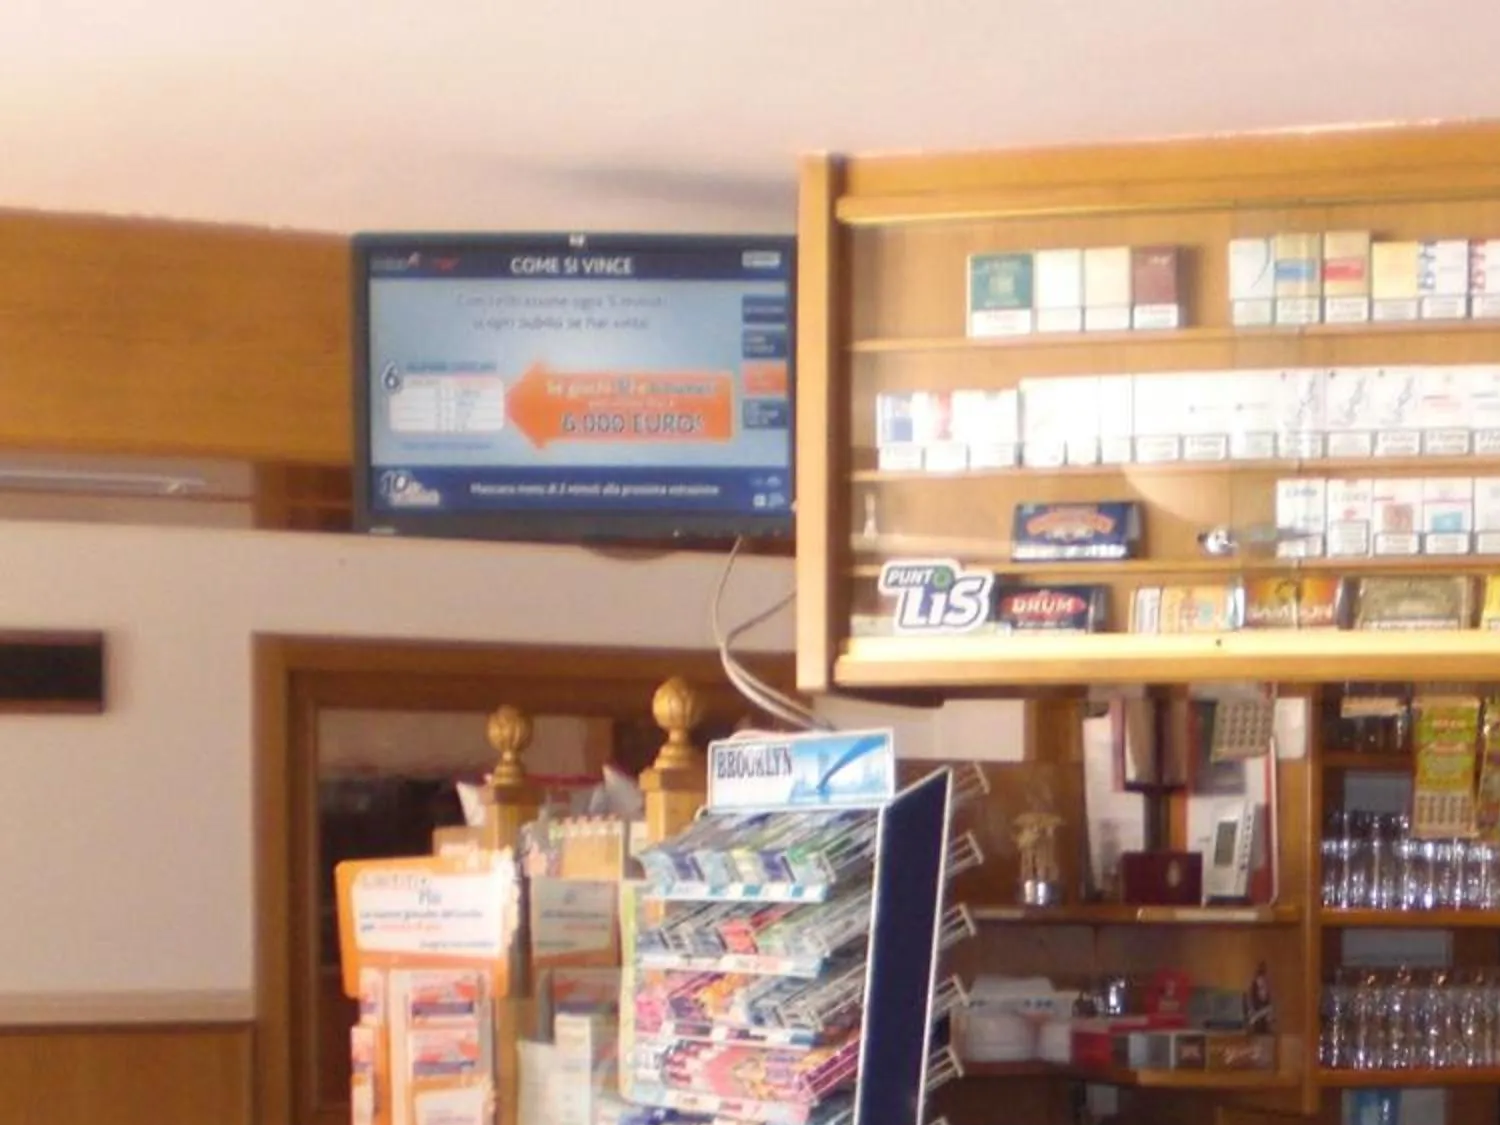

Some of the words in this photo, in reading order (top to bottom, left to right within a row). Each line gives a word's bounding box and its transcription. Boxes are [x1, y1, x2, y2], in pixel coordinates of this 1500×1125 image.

[510, 257, 559, 275] COME
[563, 257, 578, 275] SI
[581, 257, 633, 275] VINCE
[886, 566, 948, 589] PUNTO
[716, 748, 792, 780] BROOKLYN
